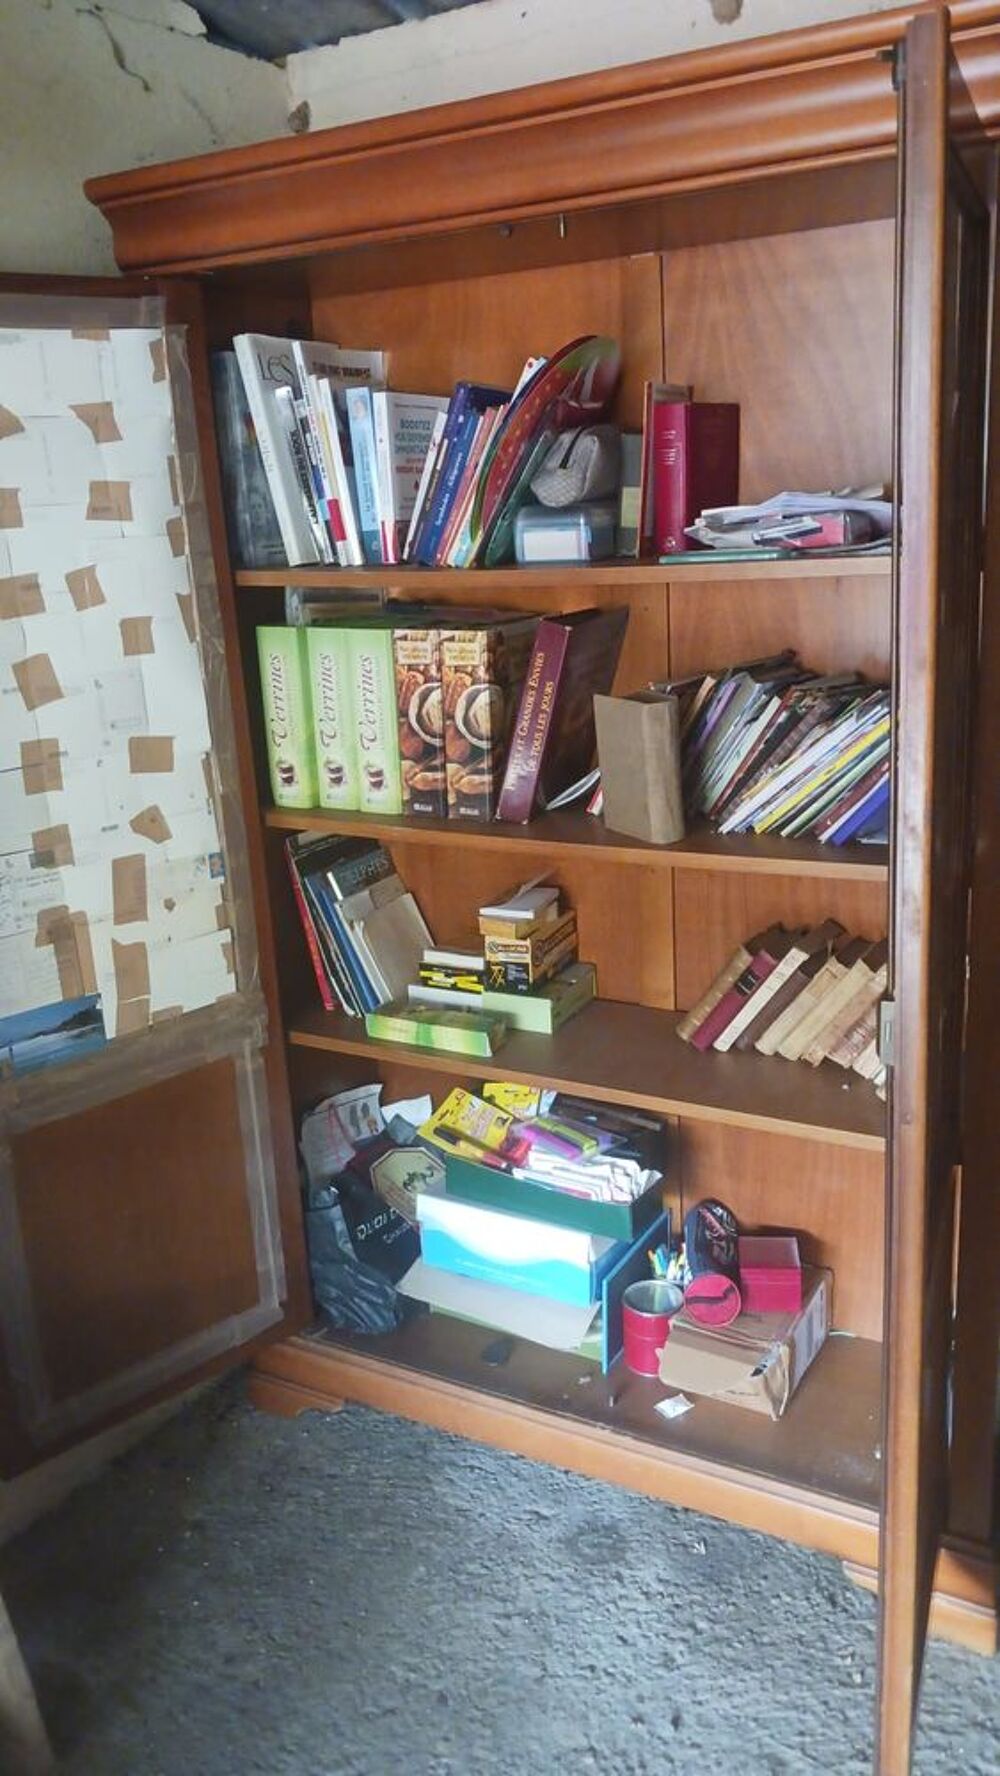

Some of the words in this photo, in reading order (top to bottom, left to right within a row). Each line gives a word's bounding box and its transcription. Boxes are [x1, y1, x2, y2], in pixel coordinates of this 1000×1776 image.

[269, 653, 288, 748] Verrines
[319, 652, 338, 749] Verrines
[359, 655, 377, 751] Verrines
